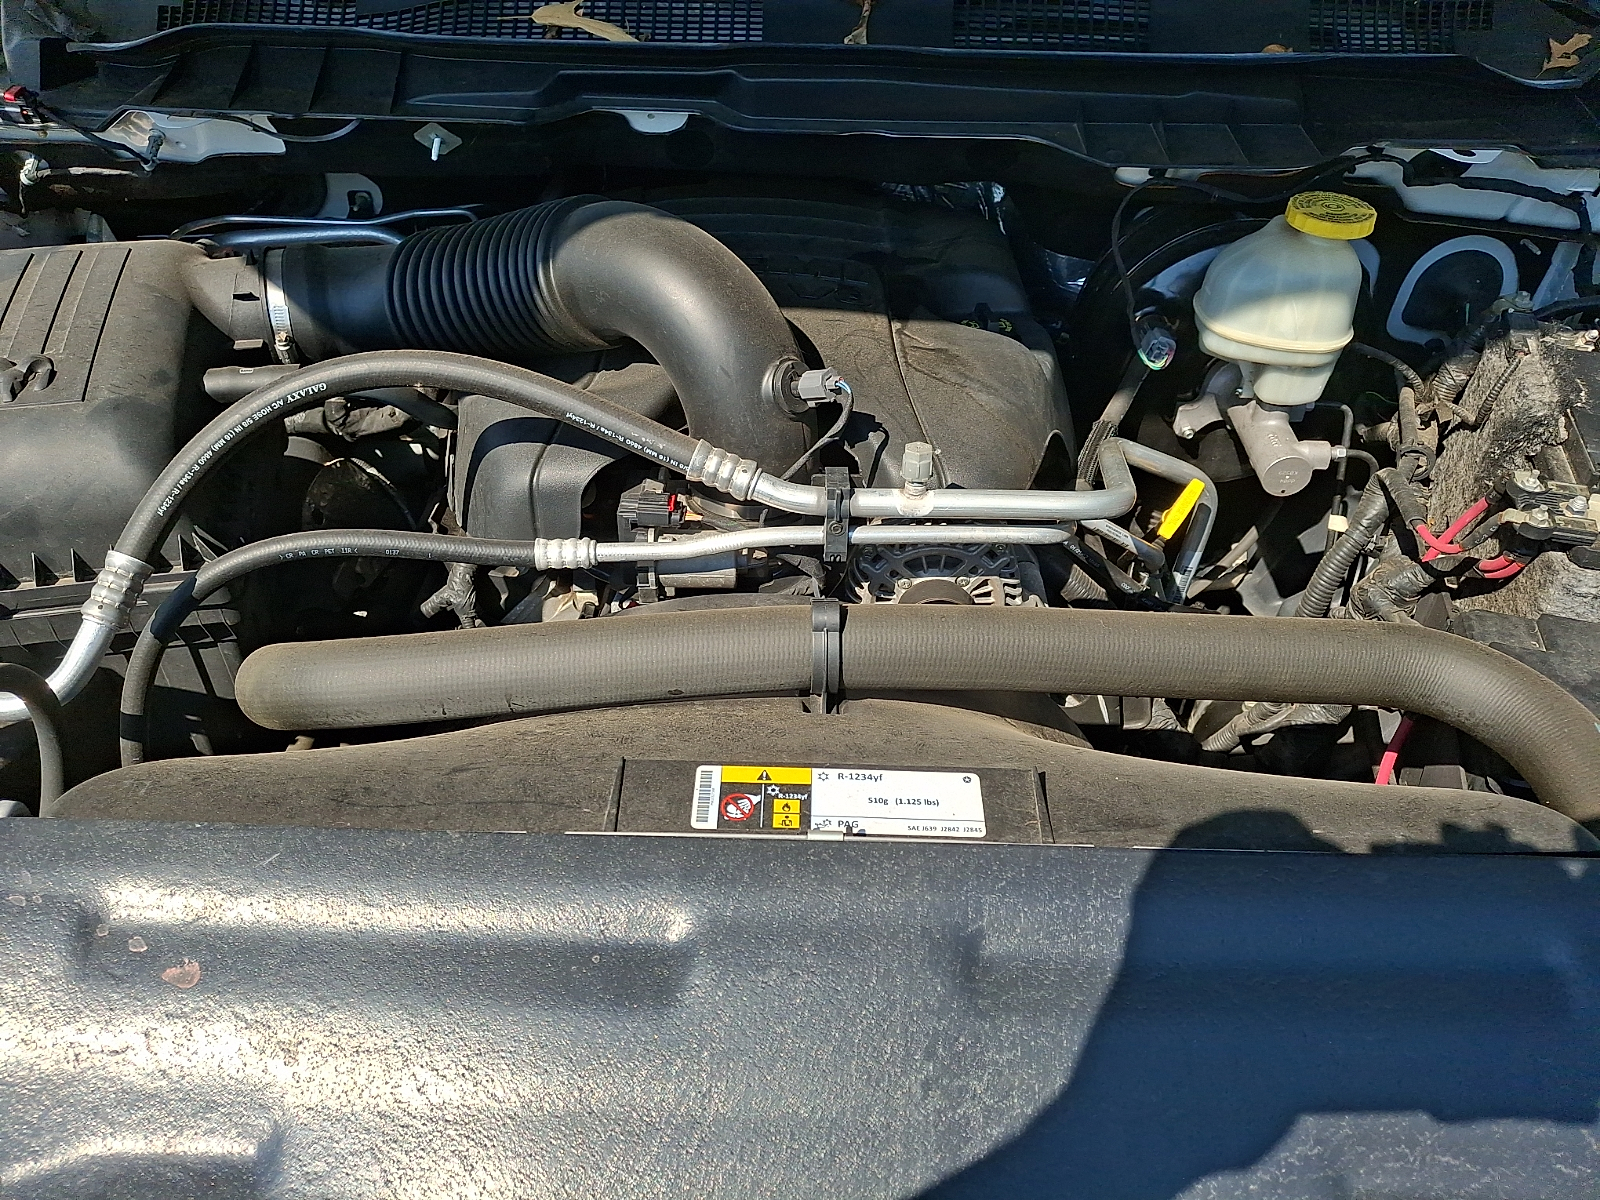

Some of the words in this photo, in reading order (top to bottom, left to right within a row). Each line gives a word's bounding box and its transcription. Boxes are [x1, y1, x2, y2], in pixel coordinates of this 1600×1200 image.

[286, 382, 327, 404] GALAXY
[271, 399, 284, 410] A/C
[252, 405, 273, 421] HOSE
[241, 418, 254, 428] 5/8
[565, 411, 597, 429] R-1234yf
[600, 427, 624, 442] R-134a
[210, 438, 227, 452] MM)
[643, 447, 658, 458] MM)
[179, 463, 200, 486] R-134a
[156, 487, 181, 517] R-1234yf
[837, 772, 883, 782] R-1234yf
[778, 793, 808, 801] R-1234yf
[868, 797, 889, 806] 510g
[895, 798, 922, 806] (1.125
[923, 799, 940, 807] lbs)
[837, 820, 859, 829] PAG
